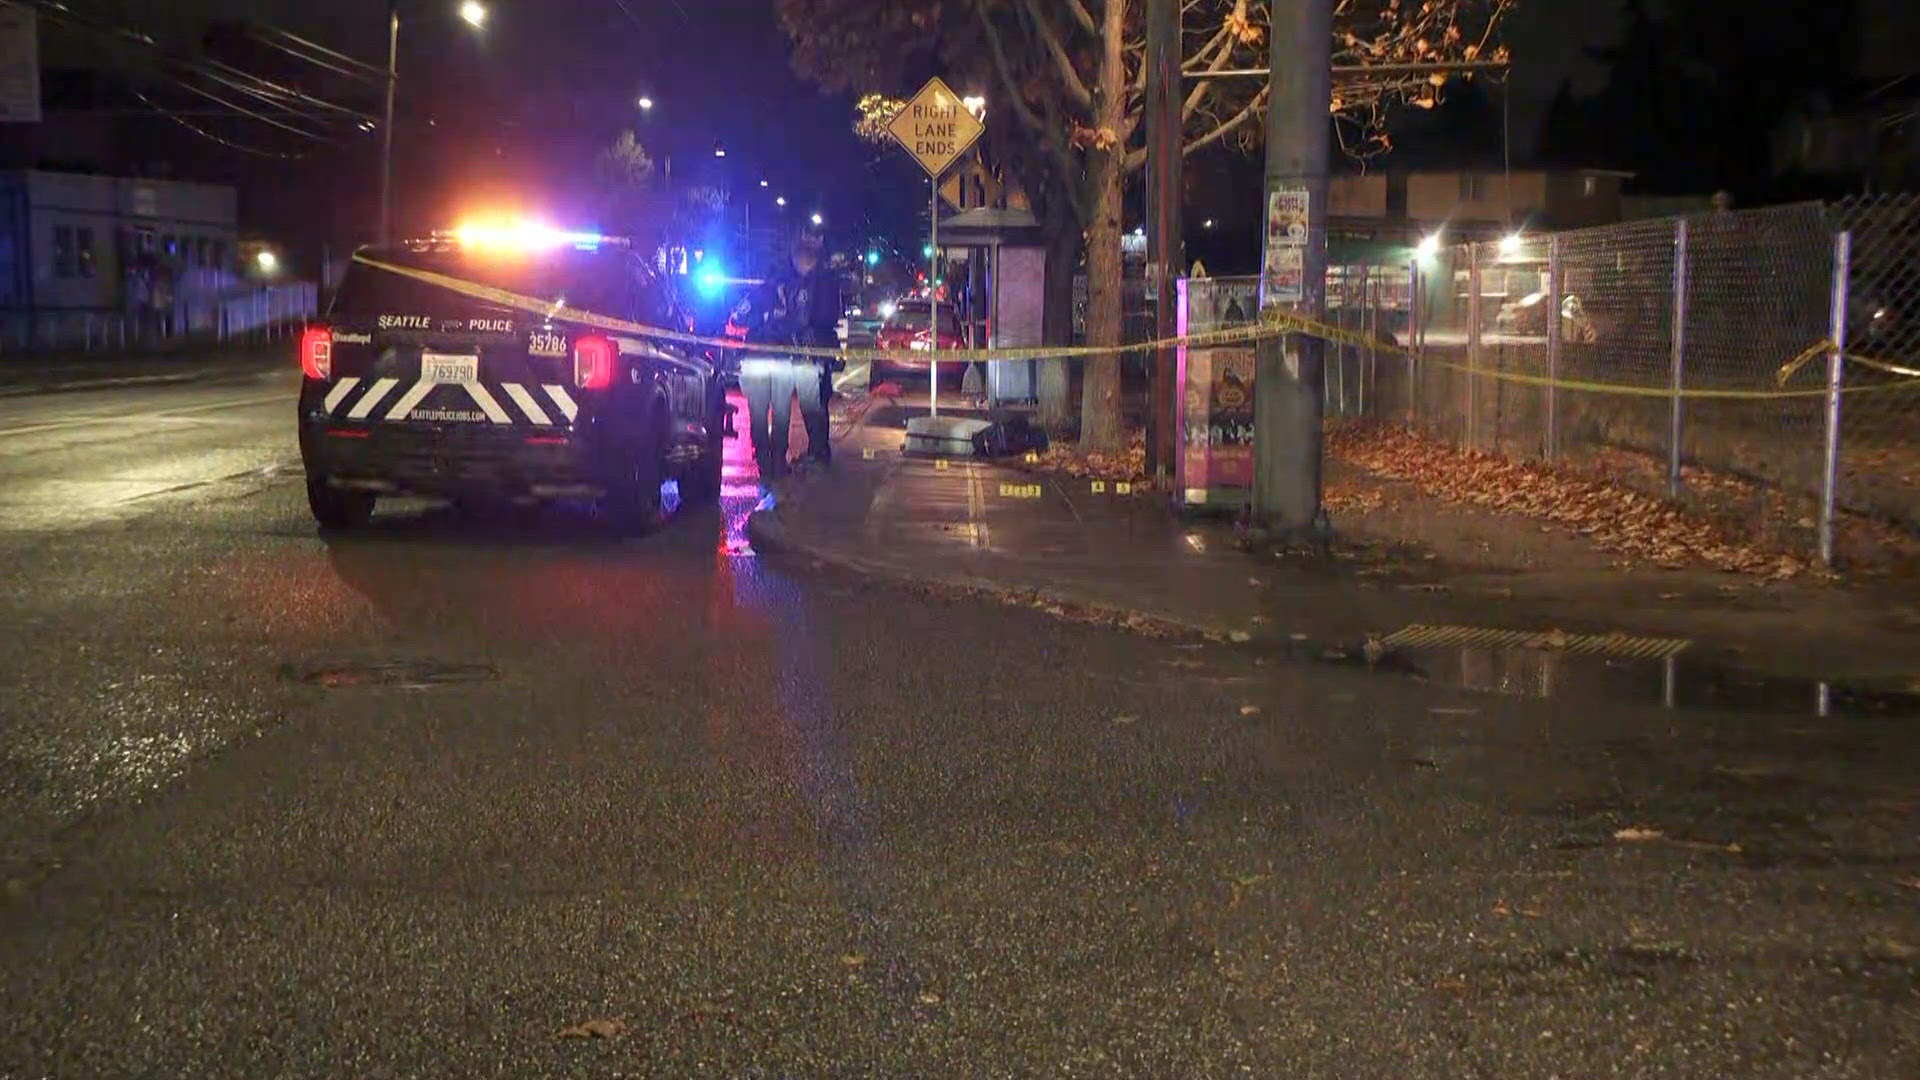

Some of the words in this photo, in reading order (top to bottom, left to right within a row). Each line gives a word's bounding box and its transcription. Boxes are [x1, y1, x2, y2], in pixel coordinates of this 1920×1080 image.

[913, 105, 957, 119] RIGHT
[915, 124, 956, 137] LANE
[916, 141, 956, 155] ENDS
[378, 315, 431, 328] SEATTLE
[469, 319, 513, 331] POLICE
